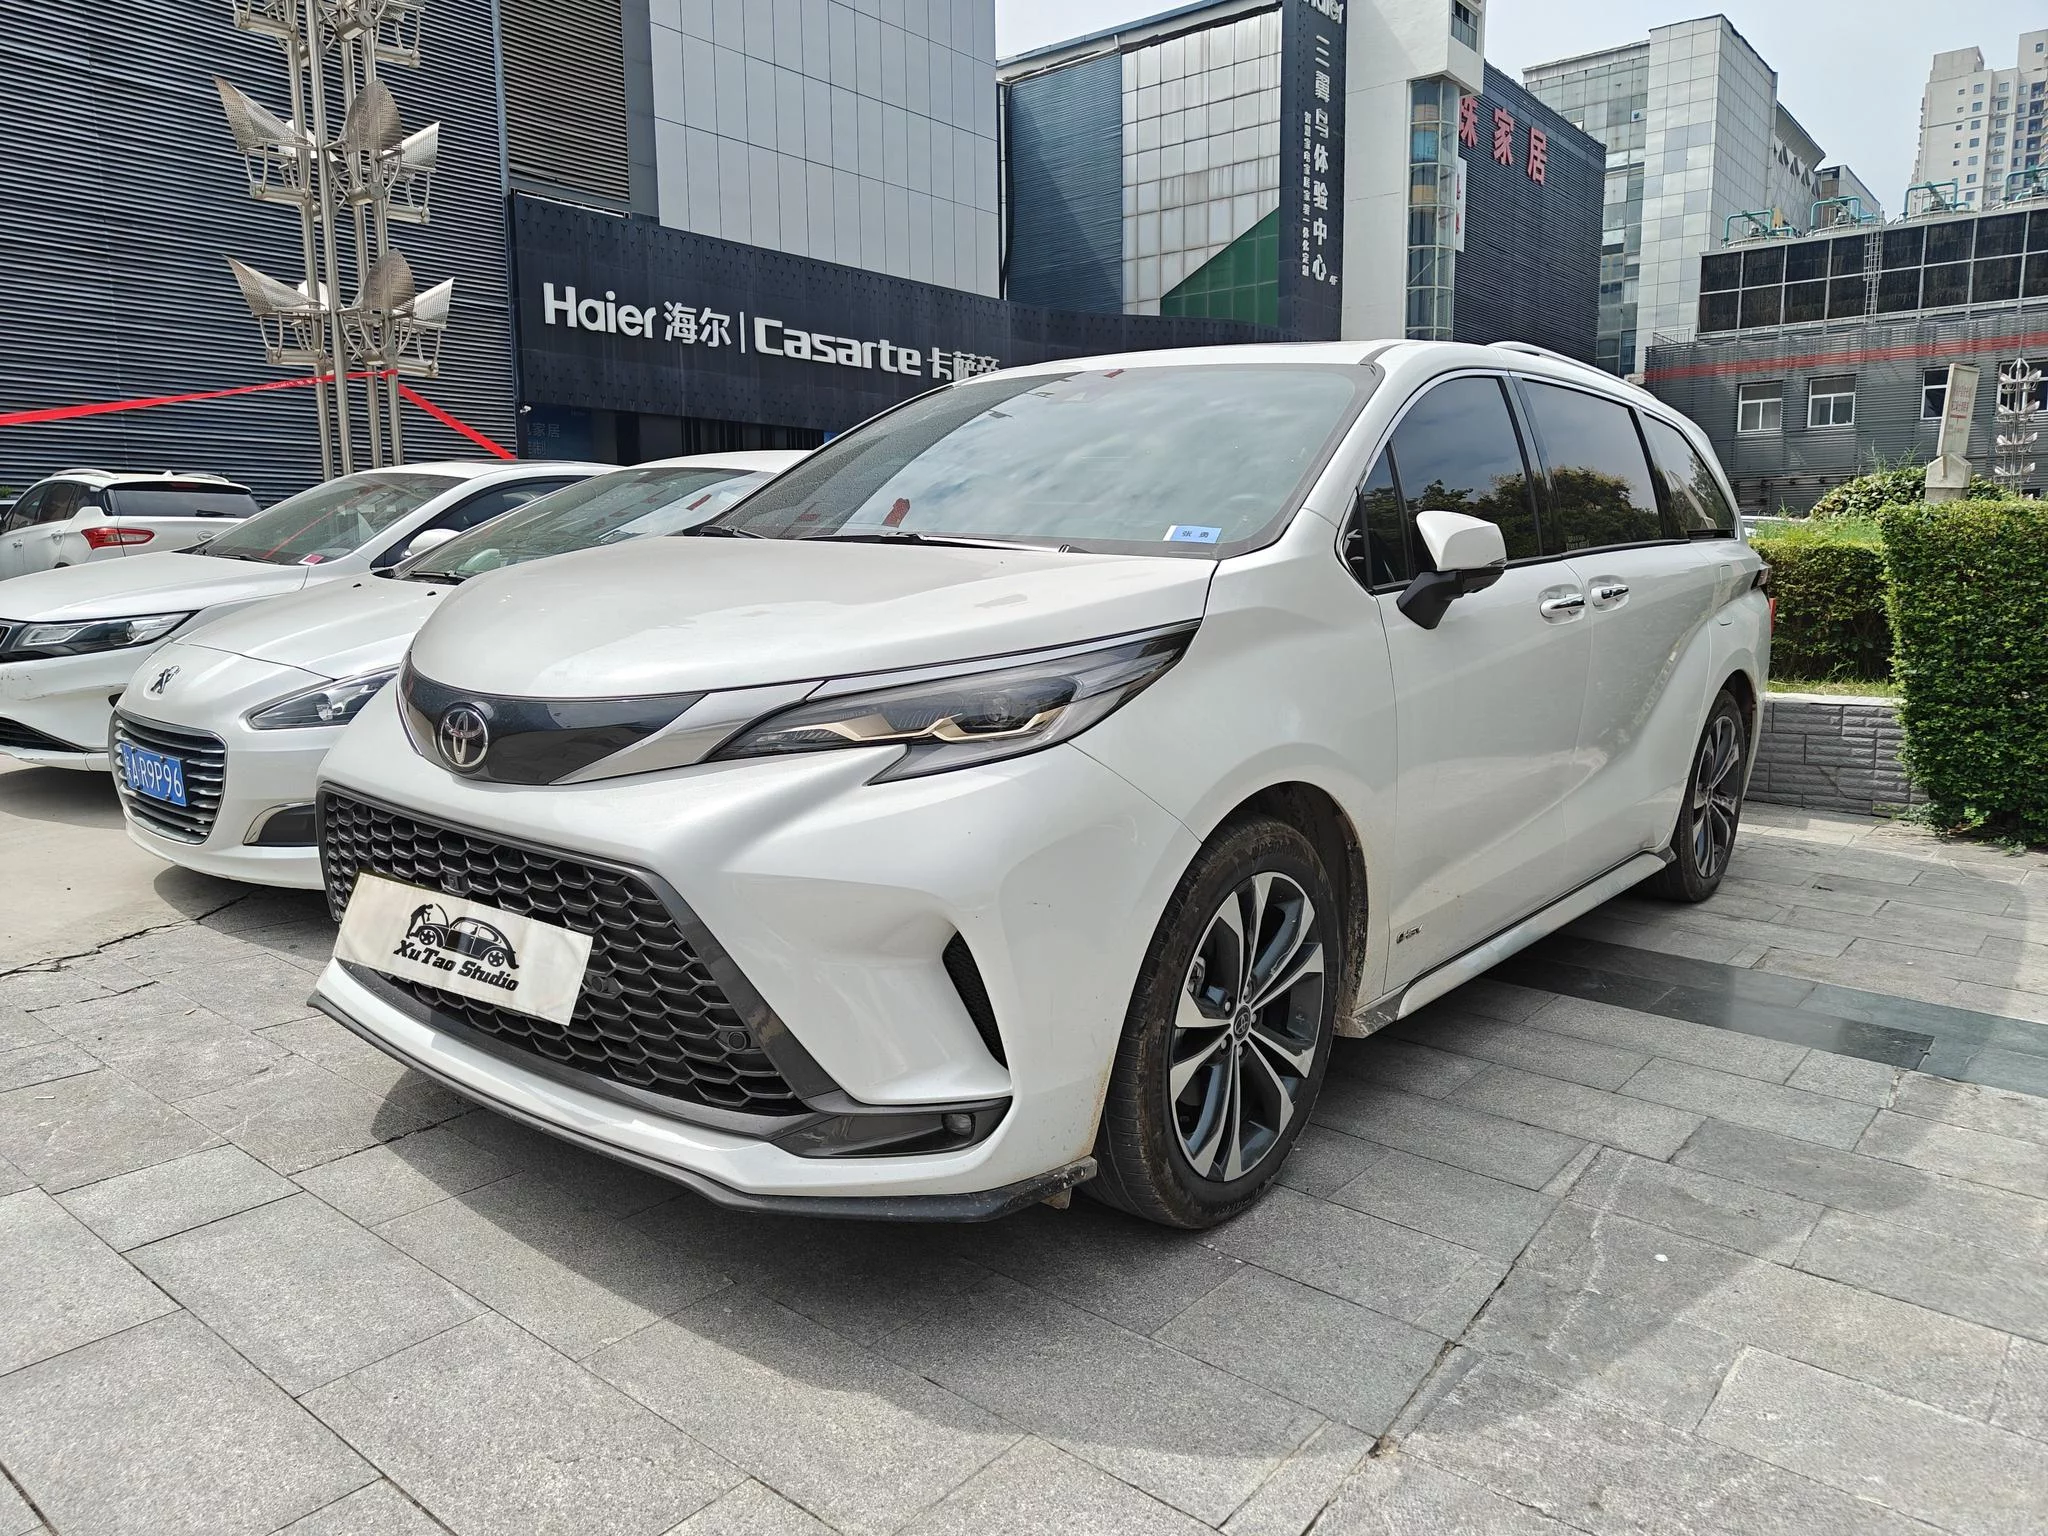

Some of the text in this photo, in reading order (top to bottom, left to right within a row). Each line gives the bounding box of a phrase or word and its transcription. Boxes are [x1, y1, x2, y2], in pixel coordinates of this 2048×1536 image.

[1303, 0, 1344, 24] aier
[1312, 35, 1330, 281] 三翼鸟体验中心
[543, 282, 656, 339] Haier
[663, 301, 732, 348] 海尔
[754, 317, 922, 376] Casarte
[393, 940, 519, 991] XuTao Studio
